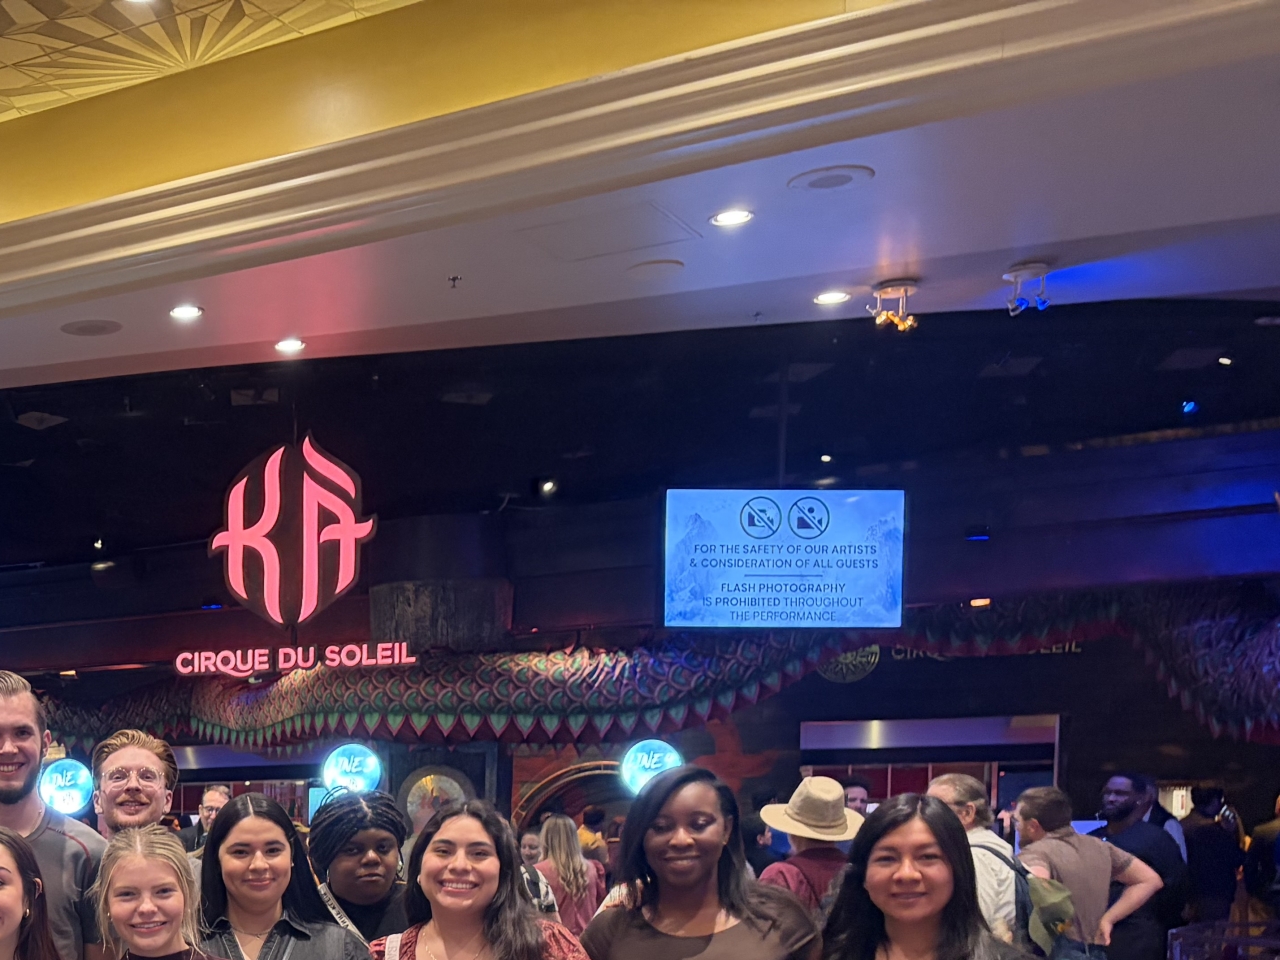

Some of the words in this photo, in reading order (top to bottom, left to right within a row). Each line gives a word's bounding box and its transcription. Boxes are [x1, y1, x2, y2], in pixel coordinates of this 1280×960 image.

[694, 544, 716, 554] FOR
[720, 544, 740, 554] THE
[743, 544, 783, 554] SAFETY
[787, 544, 802, 554] OF
[805, 544, 829, 554] OUR
[832, 544, 877, 554] ARTISTS
[690, 558, 697, 568] &
[701, 558, 792, 569] CONSIDERATION
[795, 558, 810, 569] OF
[813, 558, 833, 569] ALL
[836, 558, 878, 569] GUESTS
[721, 583, 755, 593] FLASH
[759, 583, 846, 593] PHOTOGRAPHY
[703, 597, 712, 607] IS
[715, 597, 780, 607] PROHIBITED
[783, 597, 863, 607] THROUGHOUT
[730, 611, 750, 621] THE
[753, 611, 836, 621] PERFORMANCE
[175, 648, 270, 678] CIRQUE
[278, 646, 315, 670] DU
[324, 641, 417, 668] SOLEIL
